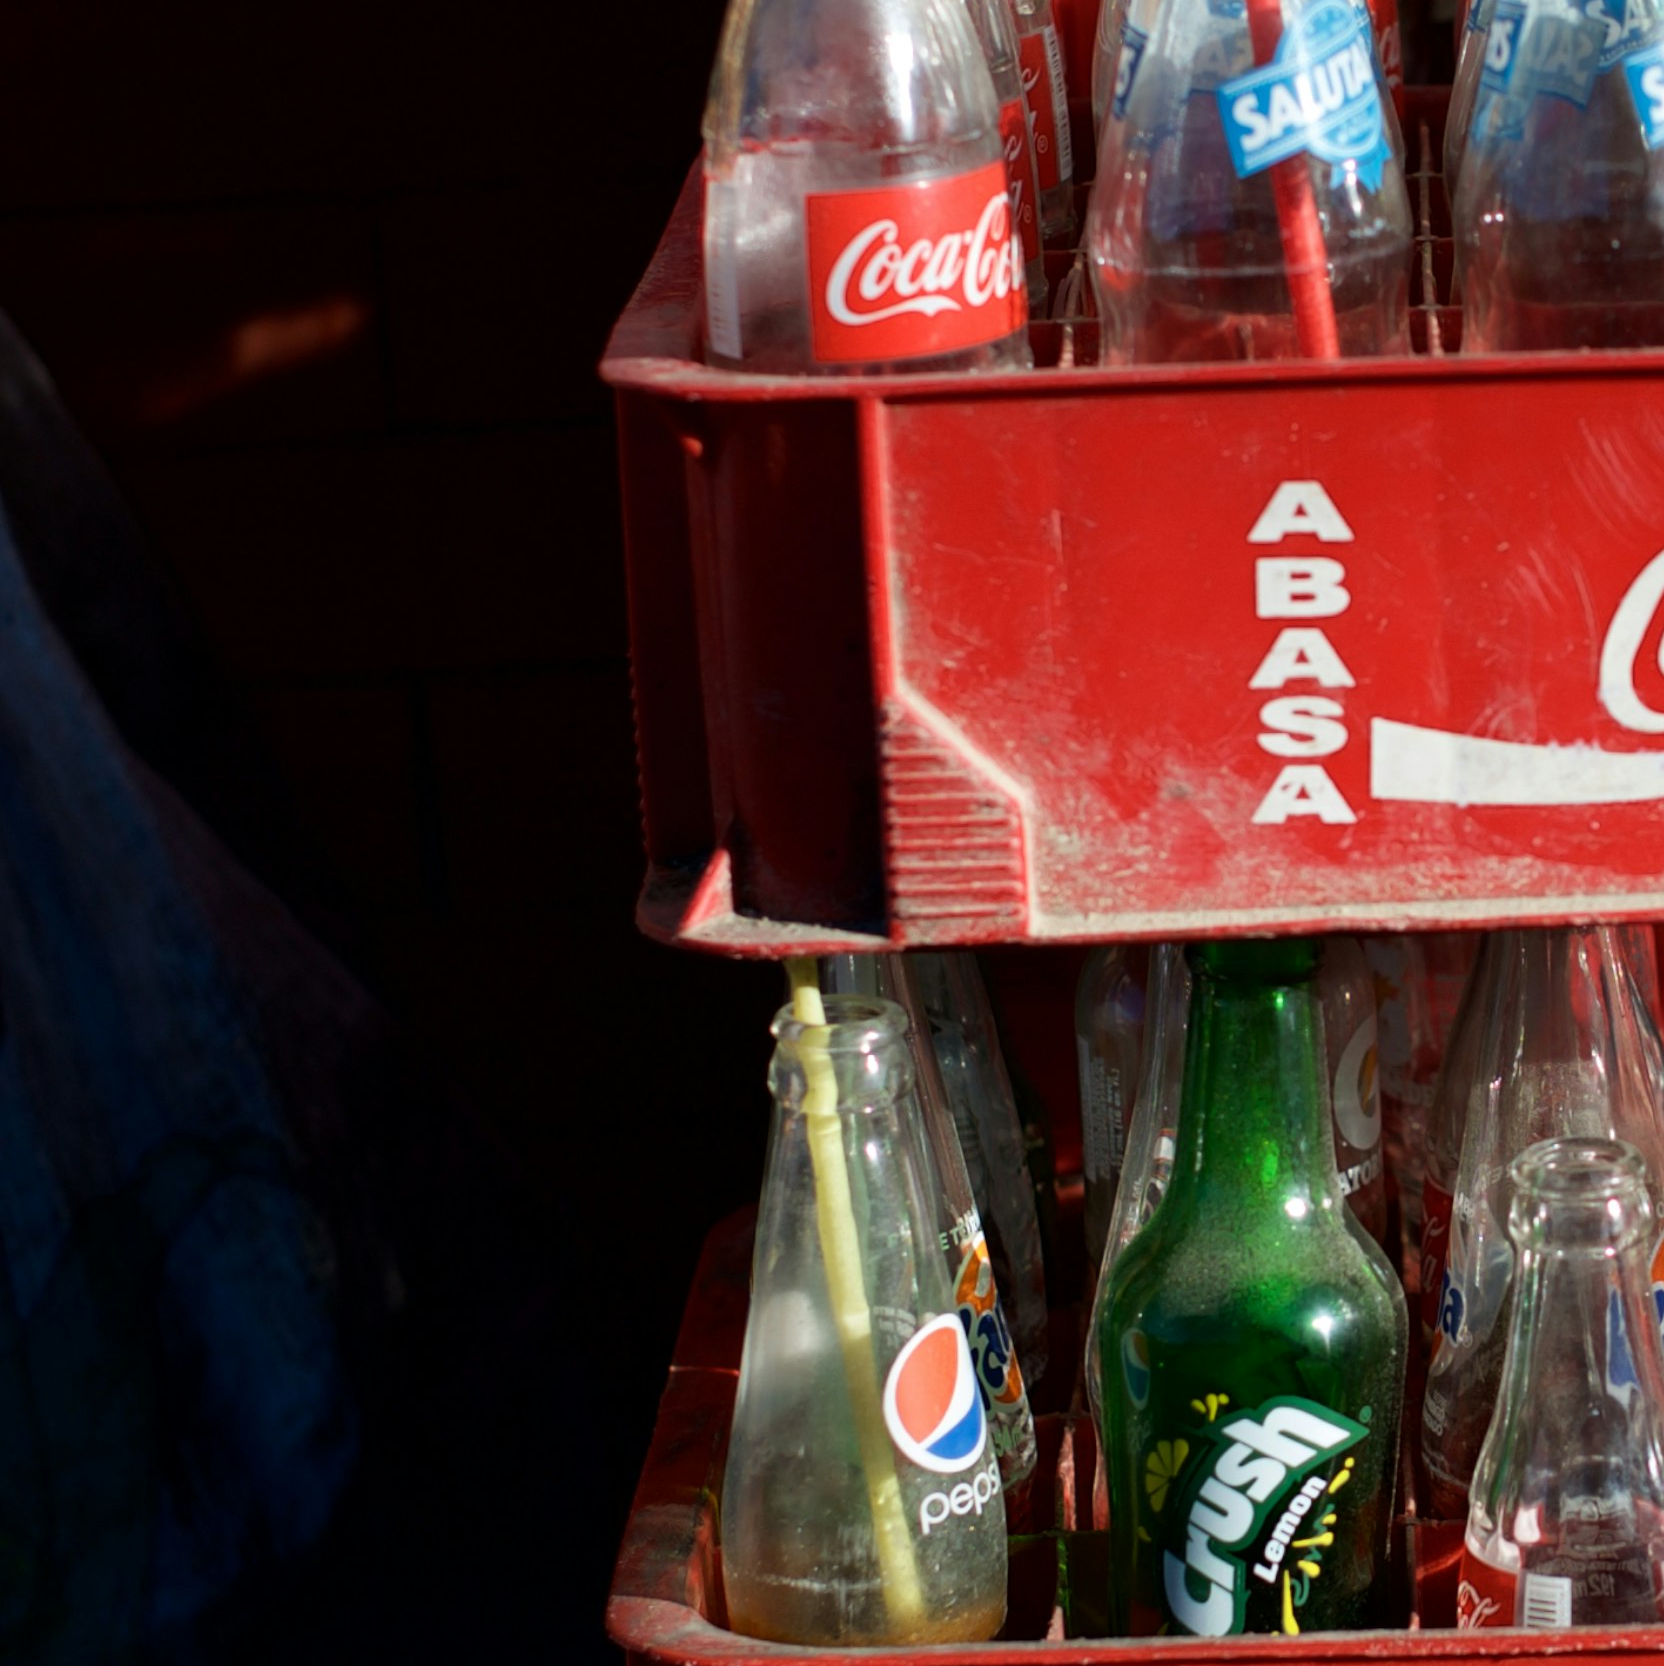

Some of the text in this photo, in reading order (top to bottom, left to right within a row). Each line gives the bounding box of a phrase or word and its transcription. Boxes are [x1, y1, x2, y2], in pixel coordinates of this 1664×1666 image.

[1232, 35, 1374, 153] SALUTA
[1248, 480, 1356, 824] ABASA
[919, 1463, 1001, 1535] peps
[1253, 1475, 1328, 1584] Lemon
